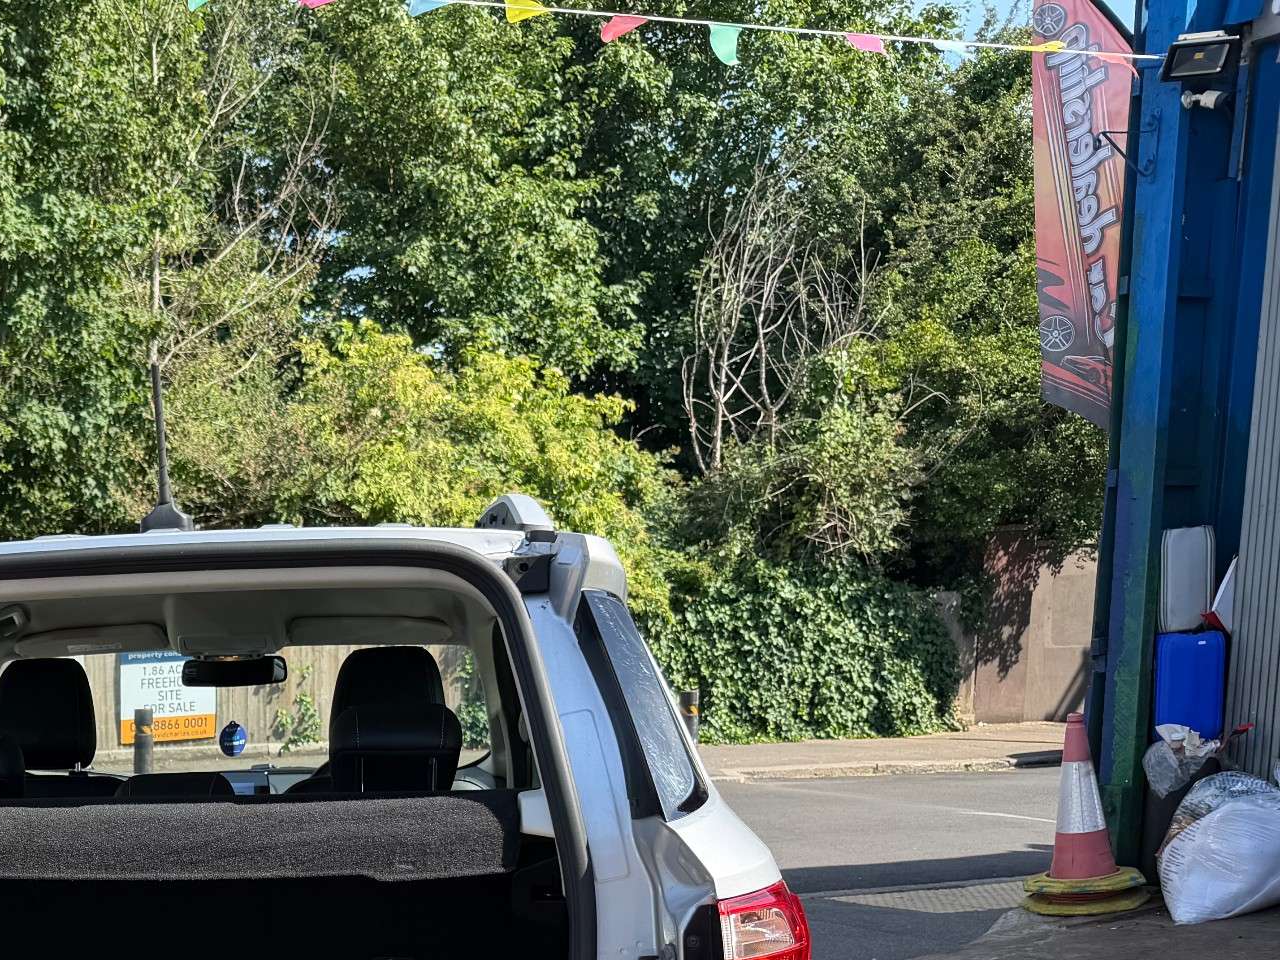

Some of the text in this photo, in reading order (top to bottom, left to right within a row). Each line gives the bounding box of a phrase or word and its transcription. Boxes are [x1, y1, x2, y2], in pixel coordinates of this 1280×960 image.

[143, 664, 182, 676] 1.86 AC
[140, 676, 183, 689] FREEHO
[158, 689, 182, 701] SITE
[168, 701, 197, 713] SALE
[153, 717, 208, 731] 8866 0001
